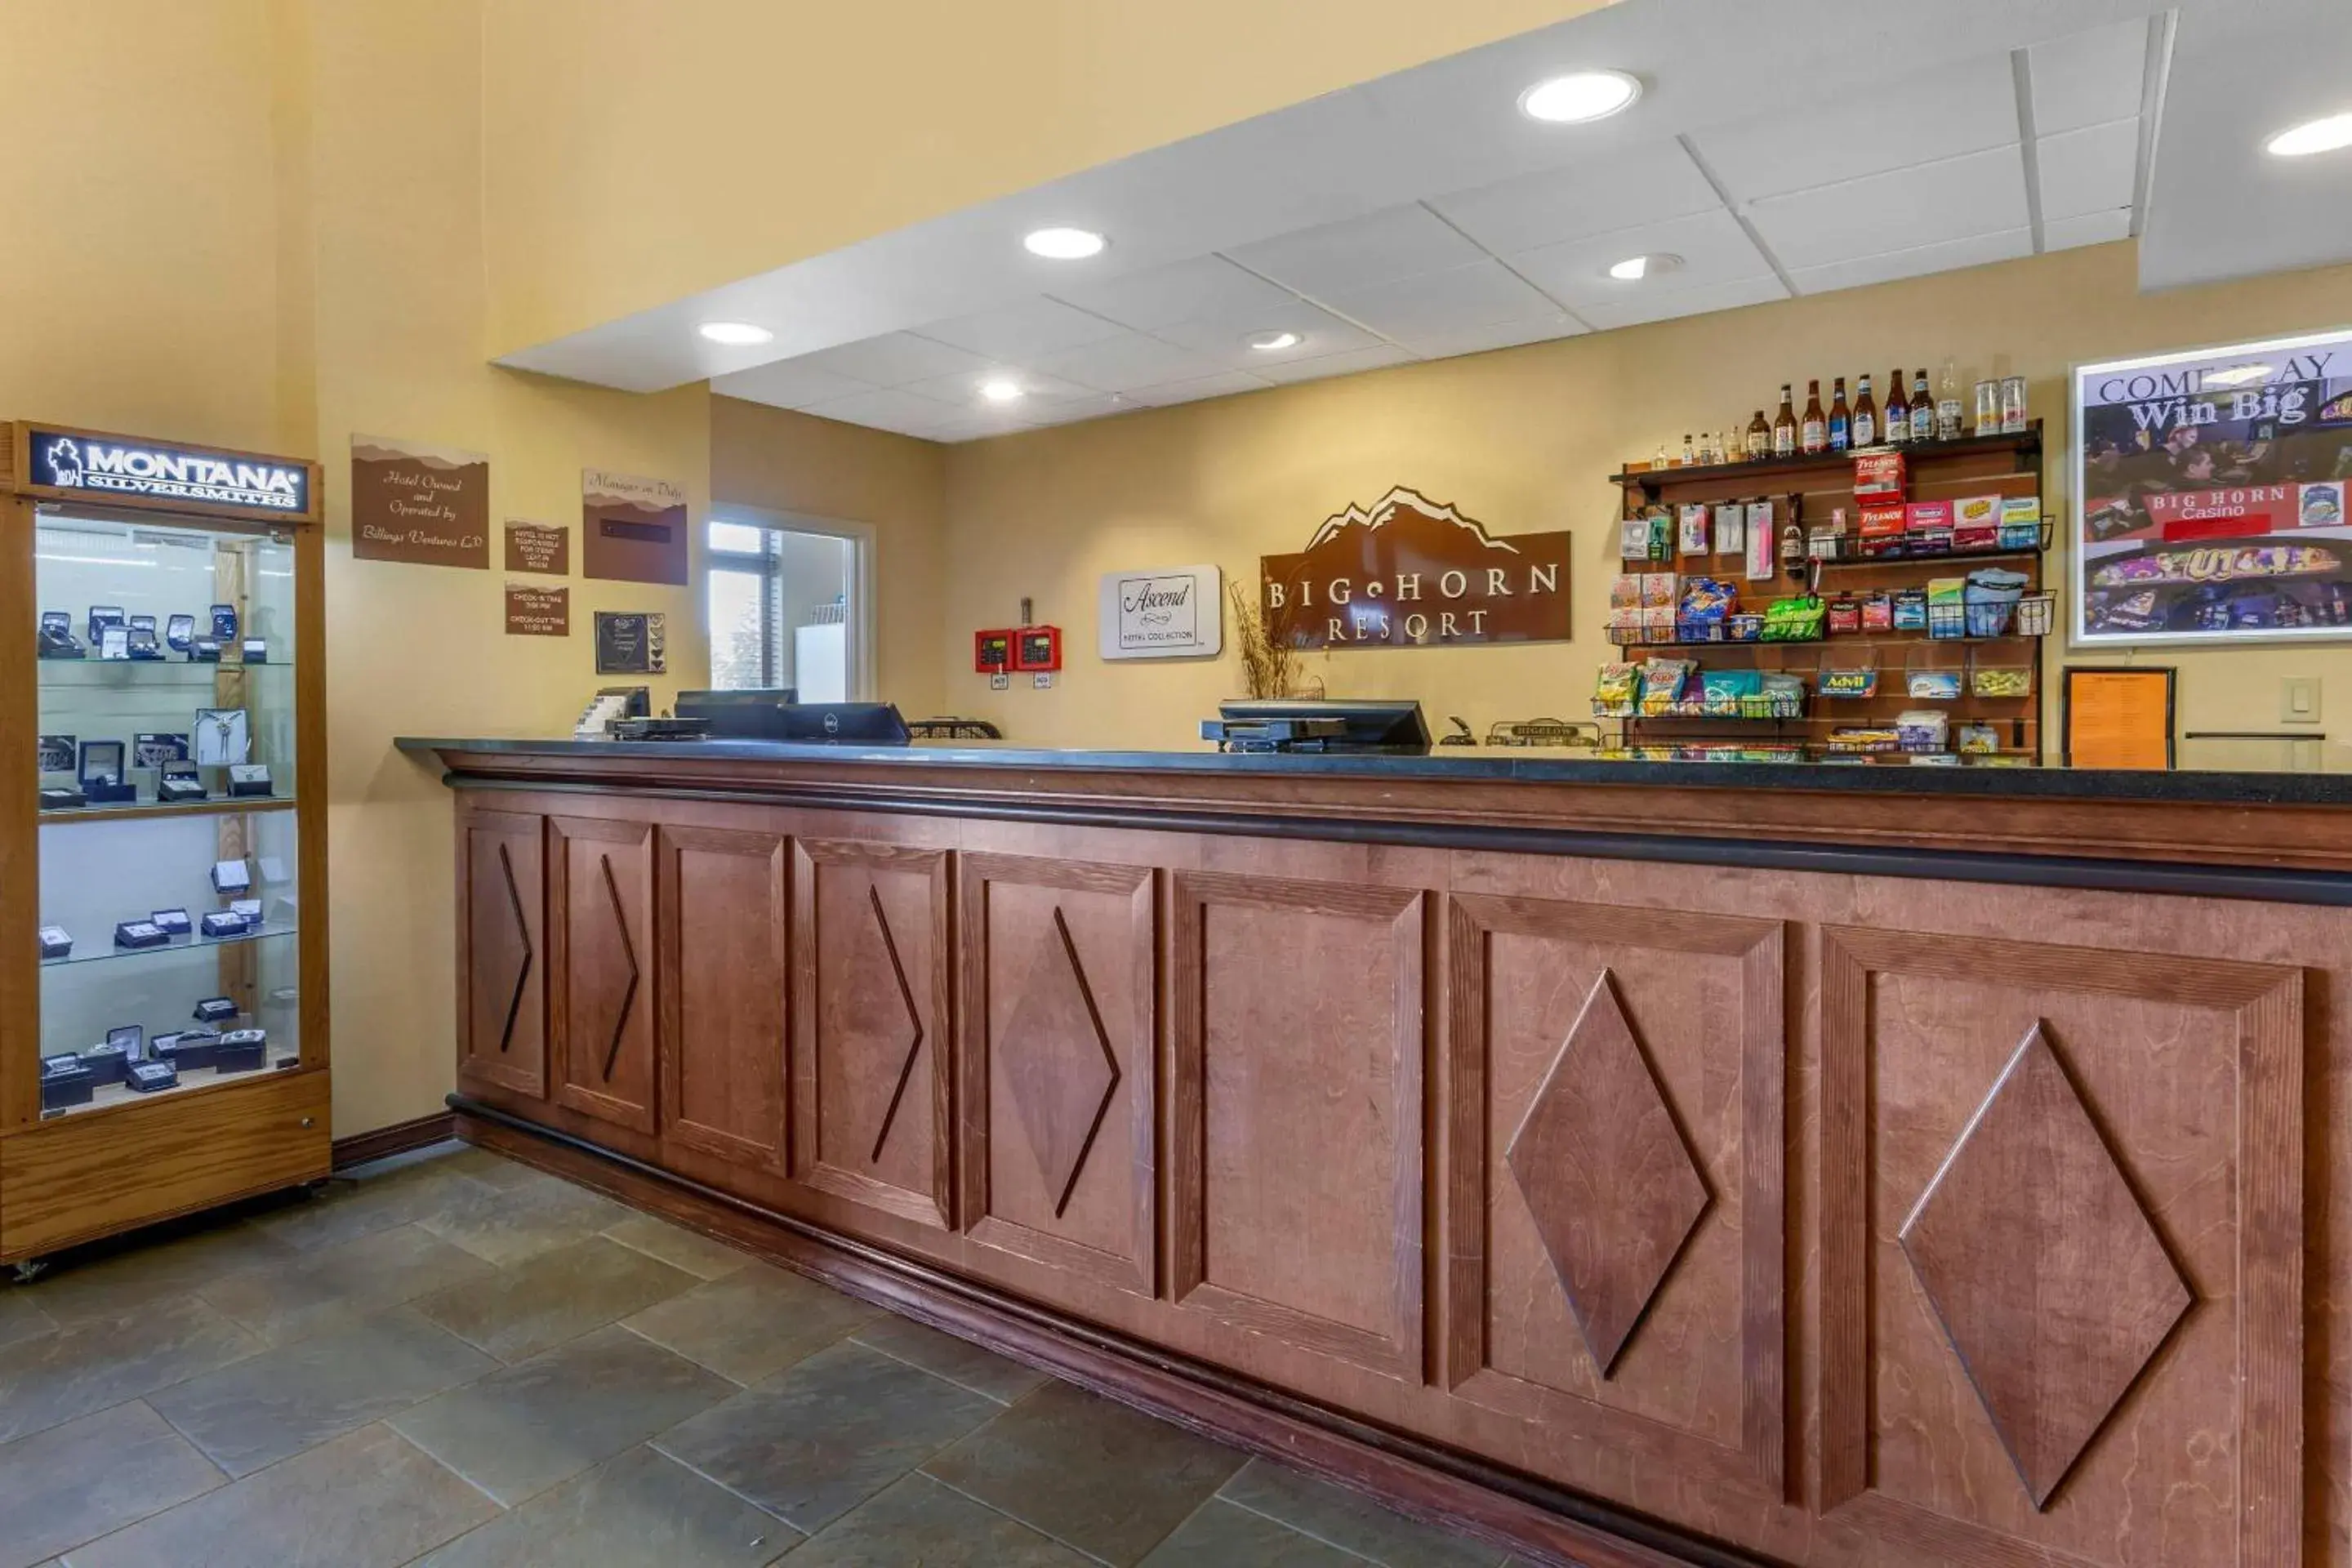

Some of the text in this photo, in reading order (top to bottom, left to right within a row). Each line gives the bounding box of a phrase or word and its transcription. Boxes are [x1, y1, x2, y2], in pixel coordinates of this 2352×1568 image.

[2127, 386, 2310, 430] Win Big
[87, 447, 296, 495] MONTANA
[383, 470, 462, 491] Hotel Owned
[87, 475, 297, 508] SILVERSMITHS
[413, 491, 434, 502] and
[2154, 487, 2285, 510] BIG HORN
[390, 499, 457, 522] Operated by
[2181, 504, 2245, 520] Casino
[363, 524, 404, 543] Billings
[1123, 582, 1190, 612] Ascend
[1268, 563, 1560, 608] BIG HORN
[1328, 609, 1488, 642] RESORT
[1827, 675, 1864, 688] Advil
